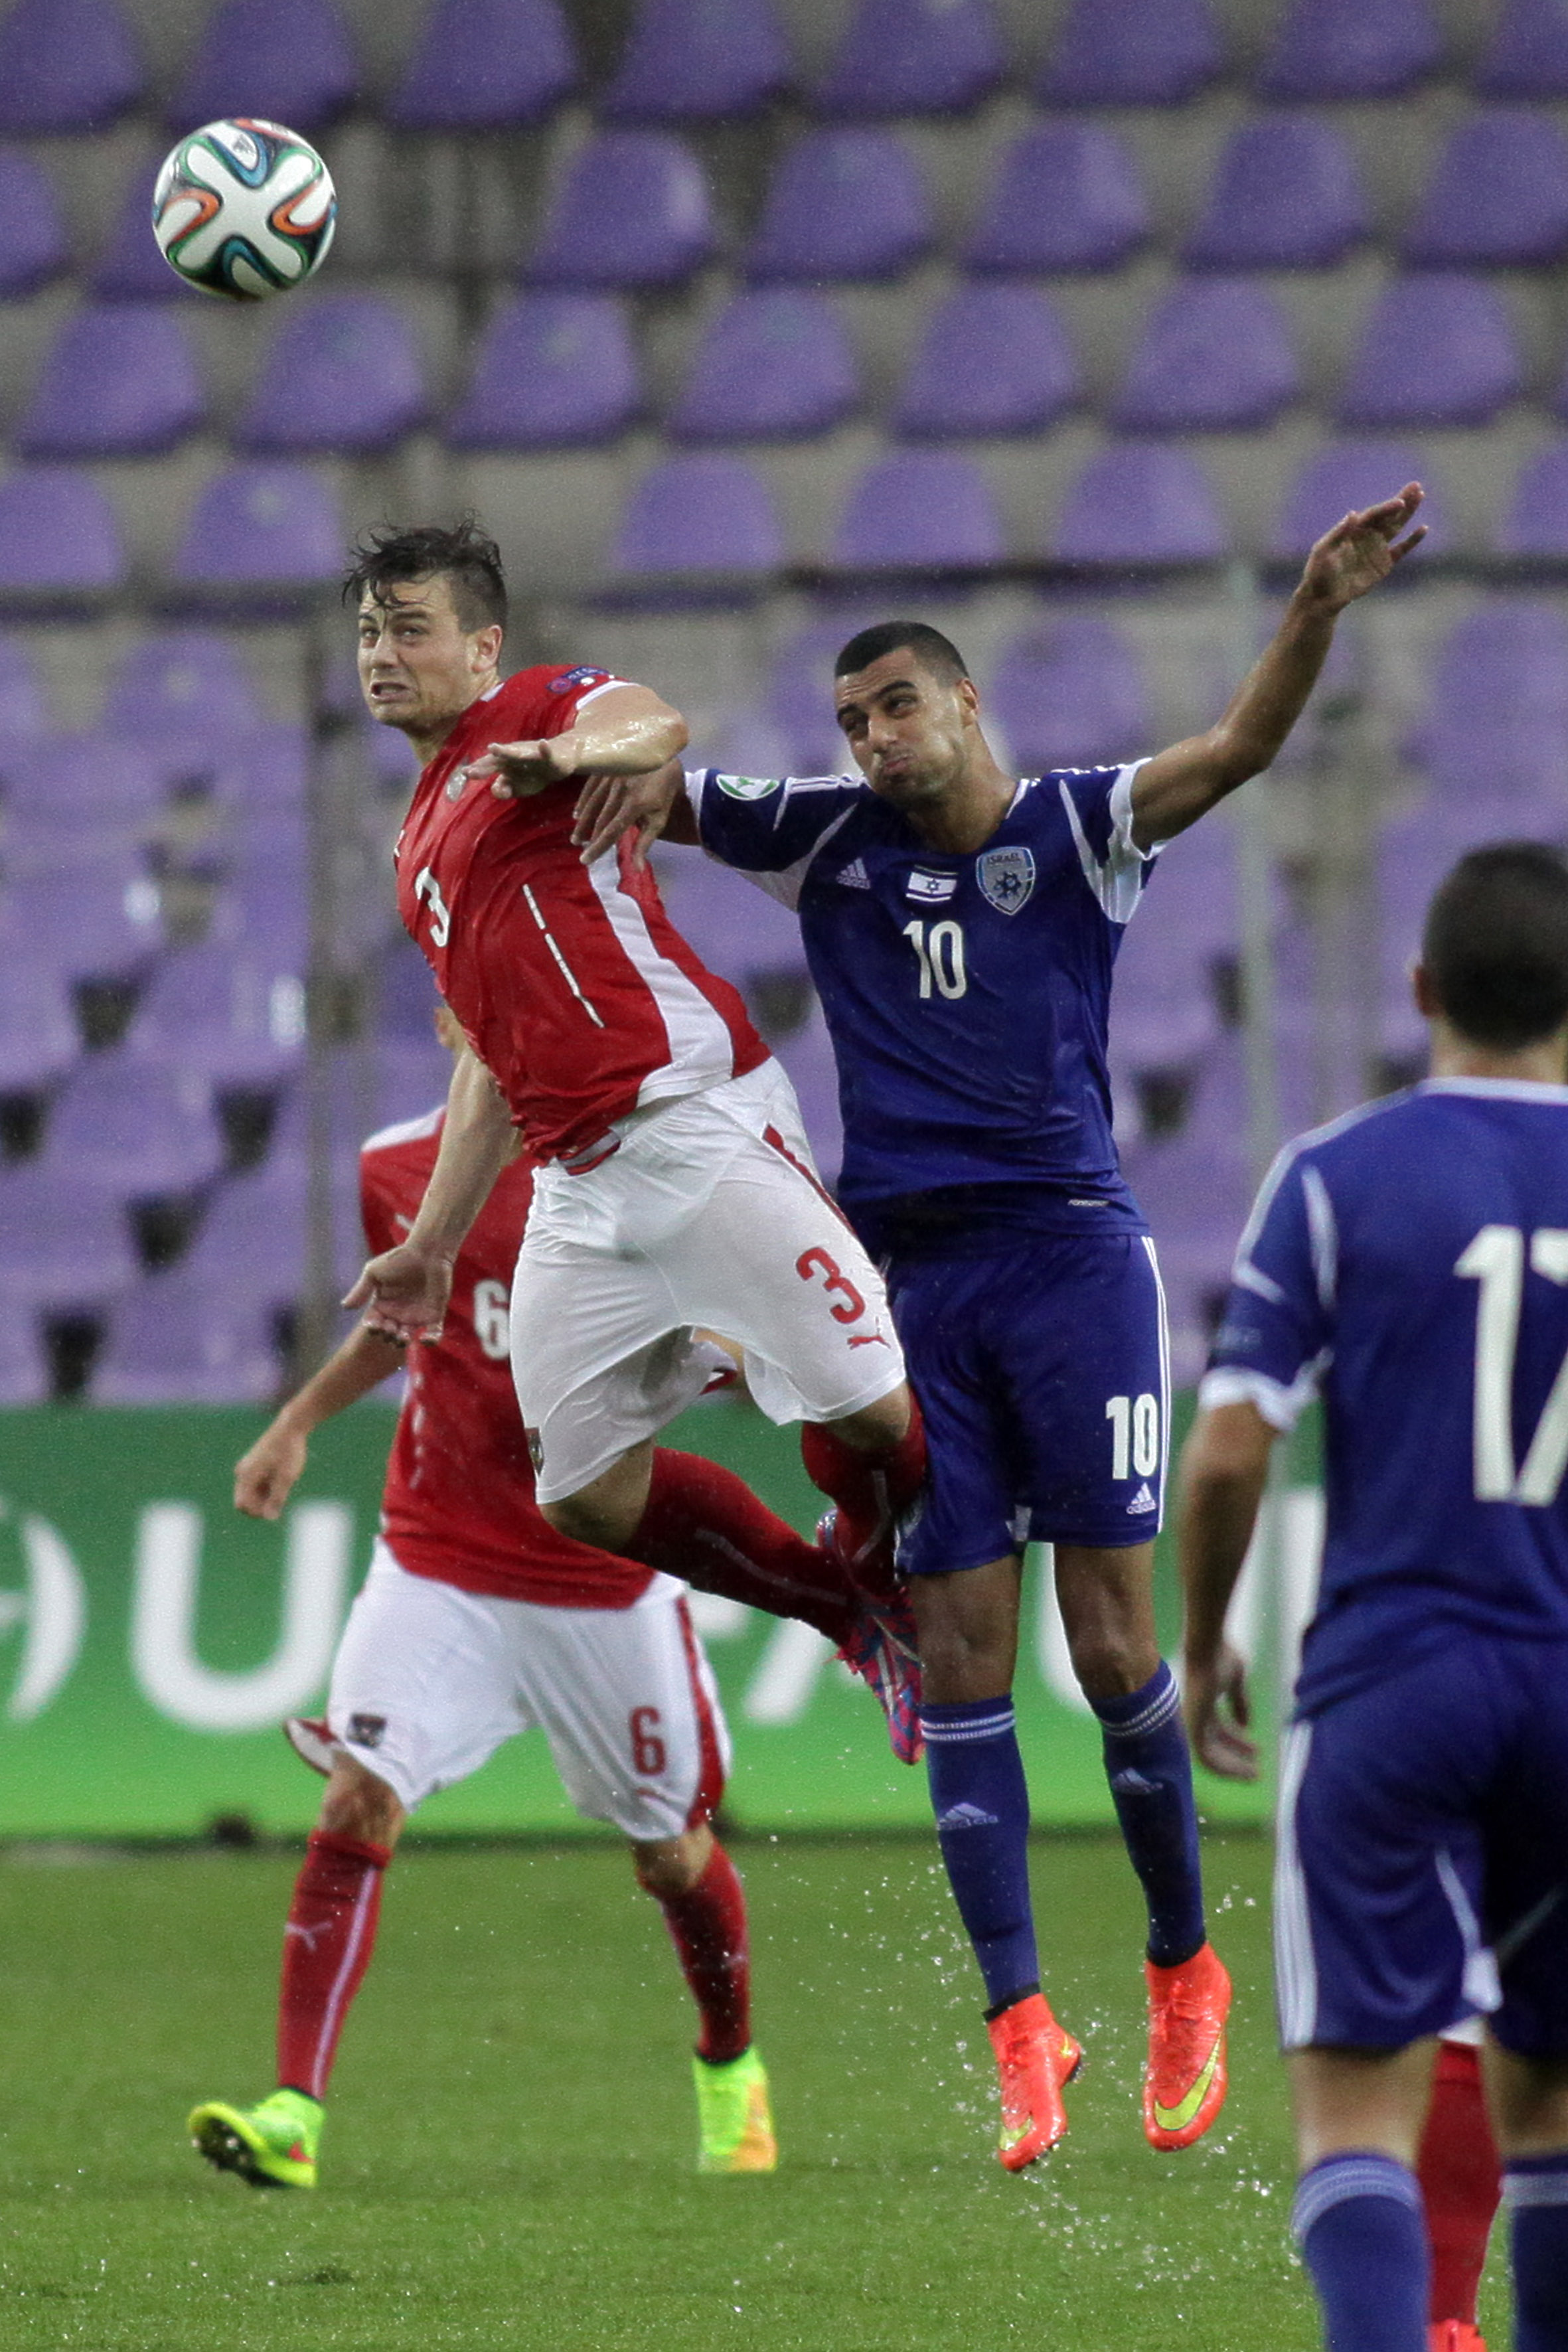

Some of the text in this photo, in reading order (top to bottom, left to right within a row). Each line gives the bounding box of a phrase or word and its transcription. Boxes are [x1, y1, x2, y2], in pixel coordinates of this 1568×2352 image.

[414, 866, 450, 947] 3
[902, 920, 967, 1000] 10
[473, 1279, 510, 1360] 6
[796, 1246, 866, 1322] 3
[1105, 1393, 1158, 1480] 10
[630, 1705, 666, 1776] 6
